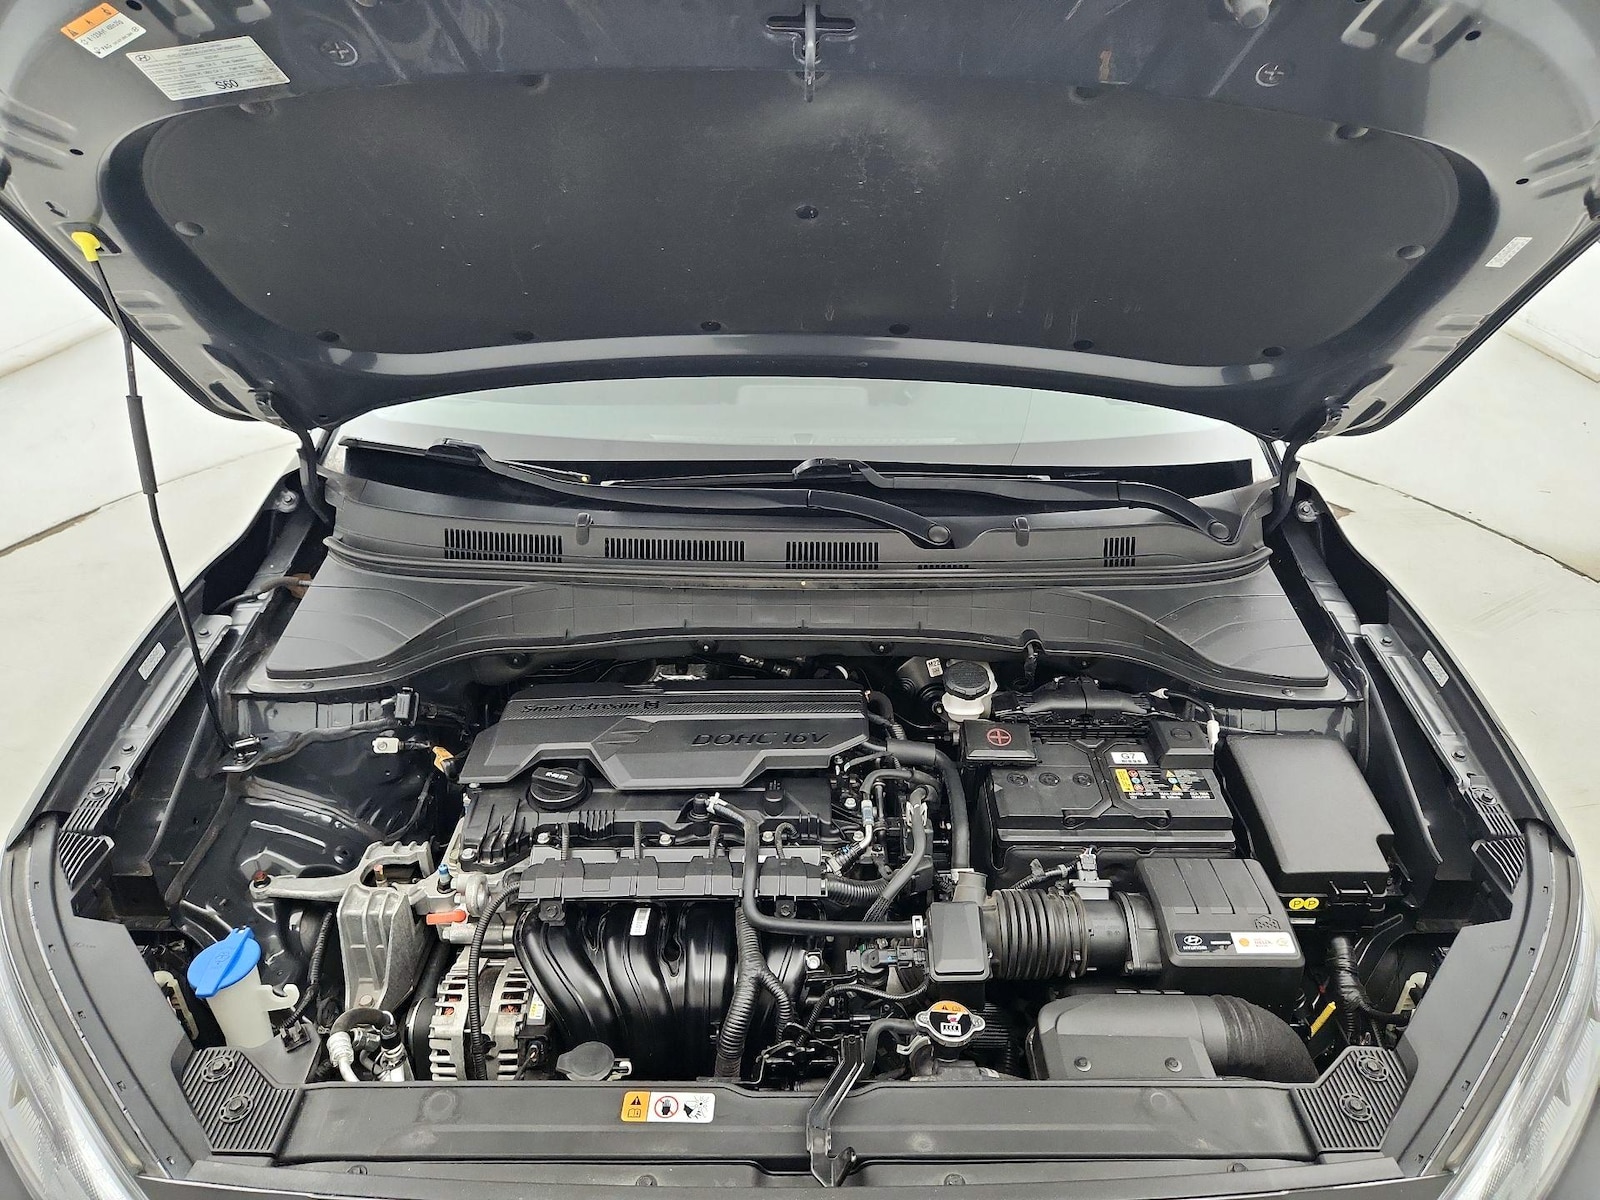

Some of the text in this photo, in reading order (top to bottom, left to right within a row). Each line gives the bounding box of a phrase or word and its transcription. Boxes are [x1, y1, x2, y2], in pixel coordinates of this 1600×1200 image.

[215, 79, 239, 90] S60
[522, 702, 640, 713] Smartstream
[691, 731, 831, 747] DOHC 16V
[1120, 752, 1136, 760] G7
